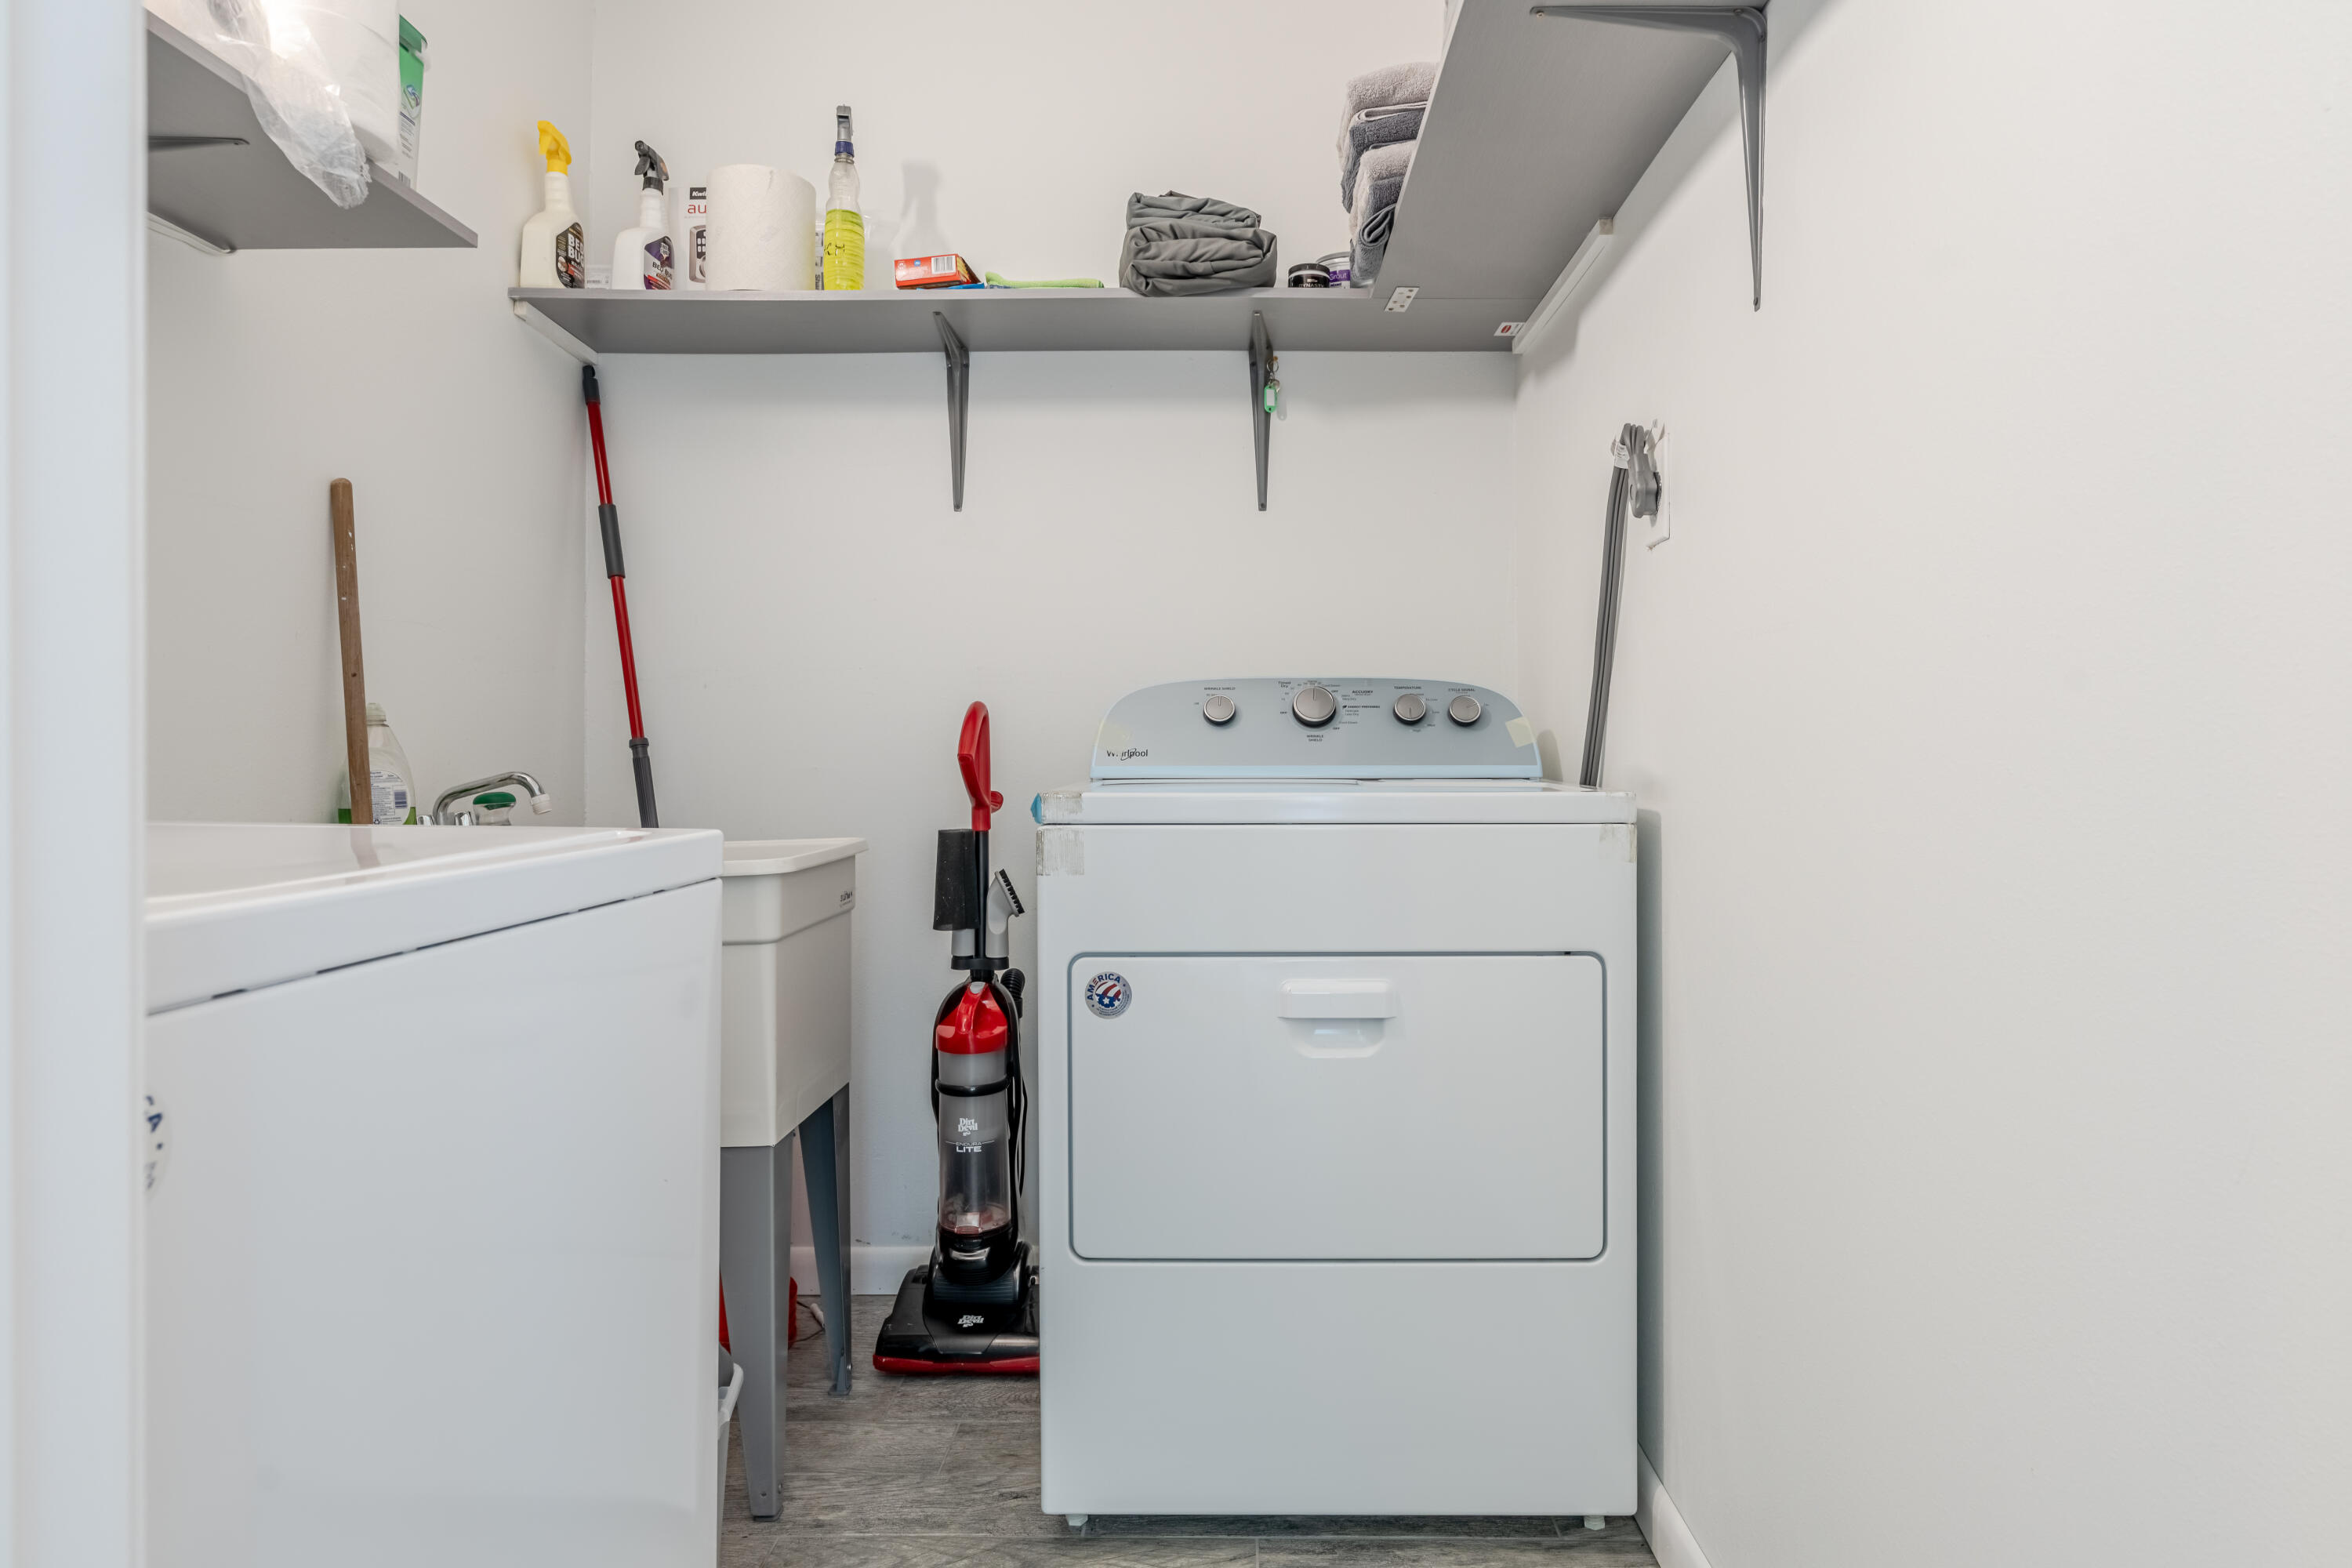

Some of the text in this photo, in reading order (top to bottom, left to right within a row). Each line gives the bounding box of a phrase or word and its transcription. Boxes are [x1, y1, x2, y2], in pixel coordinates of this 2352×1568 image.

[568, 233, 584, 255] BED
[1106, 749, 1149, 760] Wirlpool
[1087, 973, 1121, 1001] AMERICA
[958, 1123, 978, 1131] Devil
